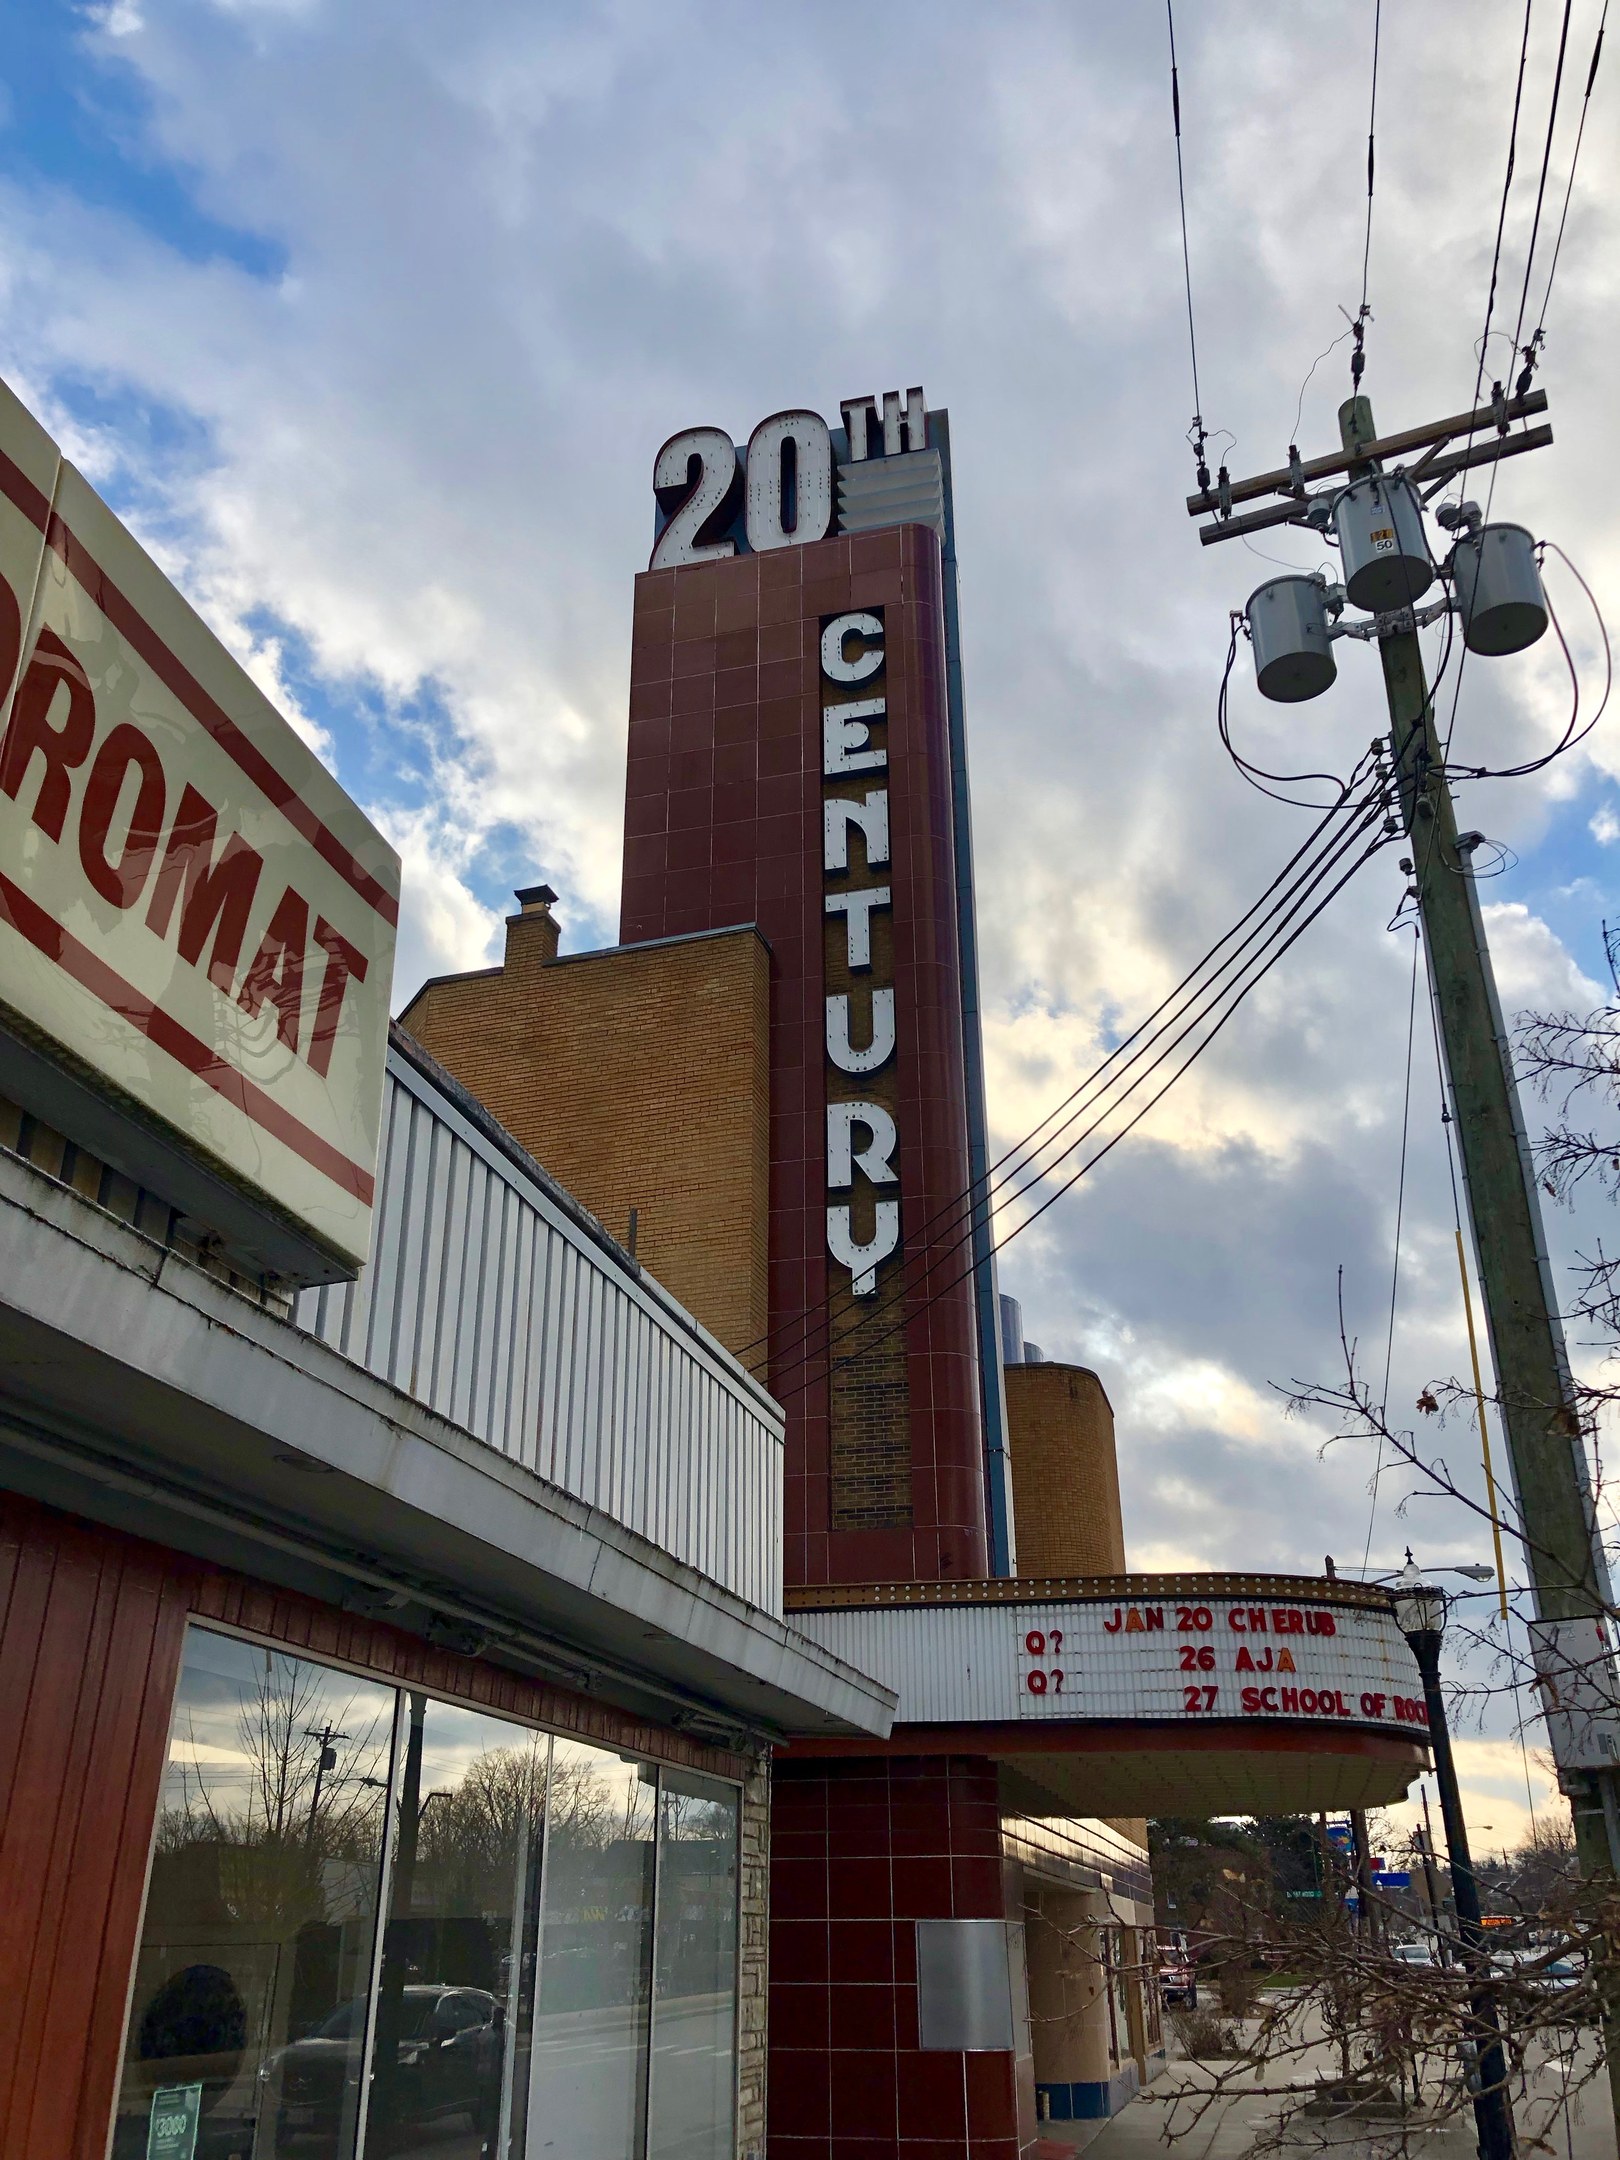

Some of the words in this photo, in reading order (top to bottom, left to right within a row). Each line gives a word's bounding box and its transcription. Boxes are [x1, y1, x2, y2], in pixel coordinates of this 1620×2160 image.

[1376, 540, 1393, 551] 50
[821, 612, 900, 1296] CENTURY
[1104, 1606, 1164, 1632] JAN
[1176, 1606, 1213, 1631] 20
[1228, 1607, 1336, 1637] CHERUB
[1025, 1629, 1063, 1655] Q?
[1179, 1645, 1216, 1671] 26
[1235, 1646, 1297, 1673] AJA
[1027, 1668, 1064, 1694] Q?
[1184, 1685, 1219, 1712] 27
[1241, 1687, 1351, 1717] SCHOOL
[1360, 1692, 1386, 1719] OF
[1393, 1695, 1430, 1726] ROC
